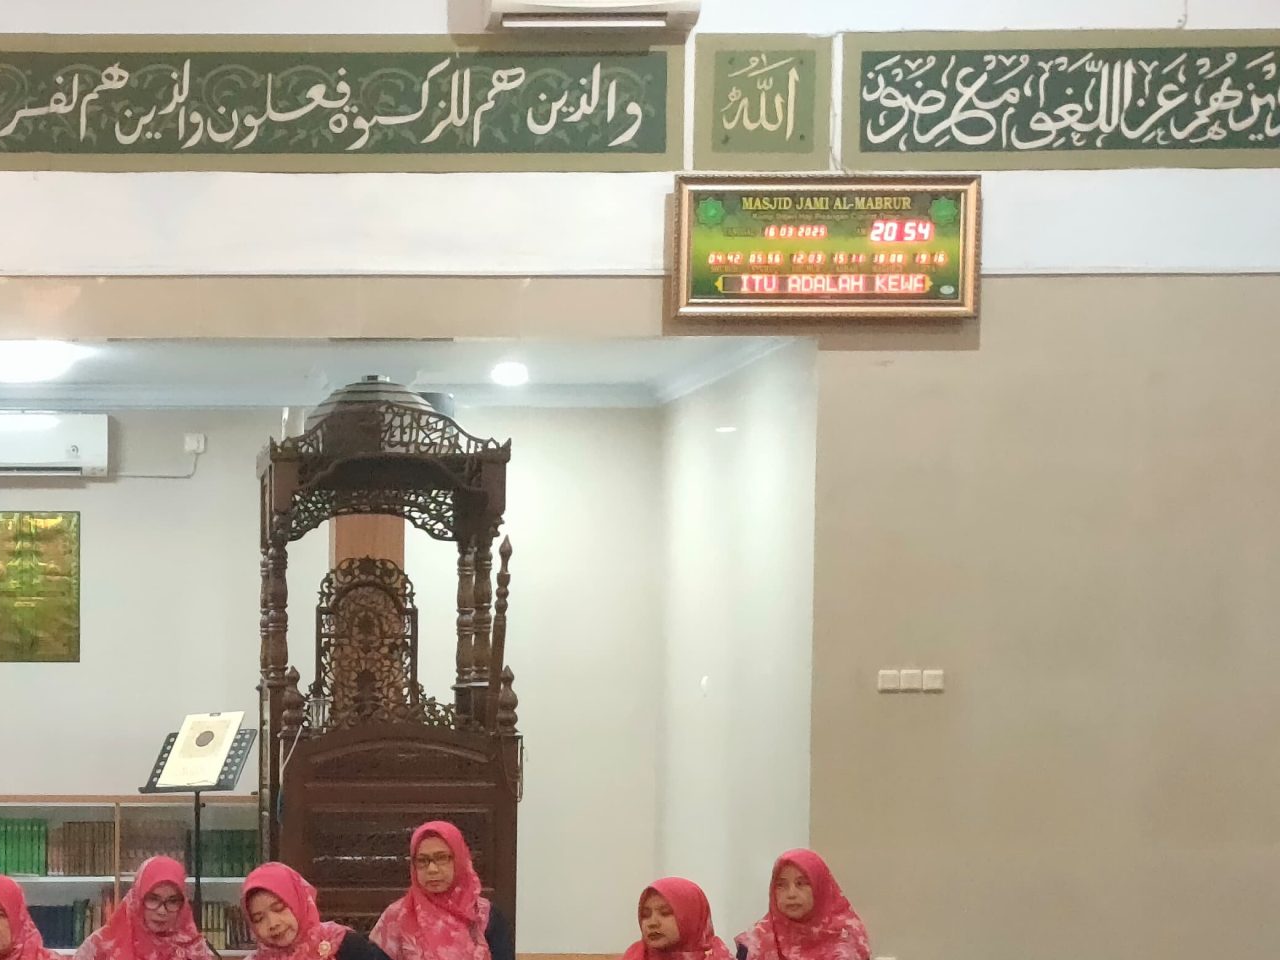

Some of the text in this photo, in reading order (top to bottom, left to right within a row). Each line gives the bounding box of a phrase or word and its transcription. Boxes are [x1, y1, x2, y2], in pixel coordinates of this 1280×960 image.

[742, 197, 912, 210] MASJID JAMI AL-MABRUR
[870, 223, 897, 241] 20
[903, 222, 931, 241] 54
[741, 274, 778, 292] ITU
[787, 274, 864, 292] ADALAH
